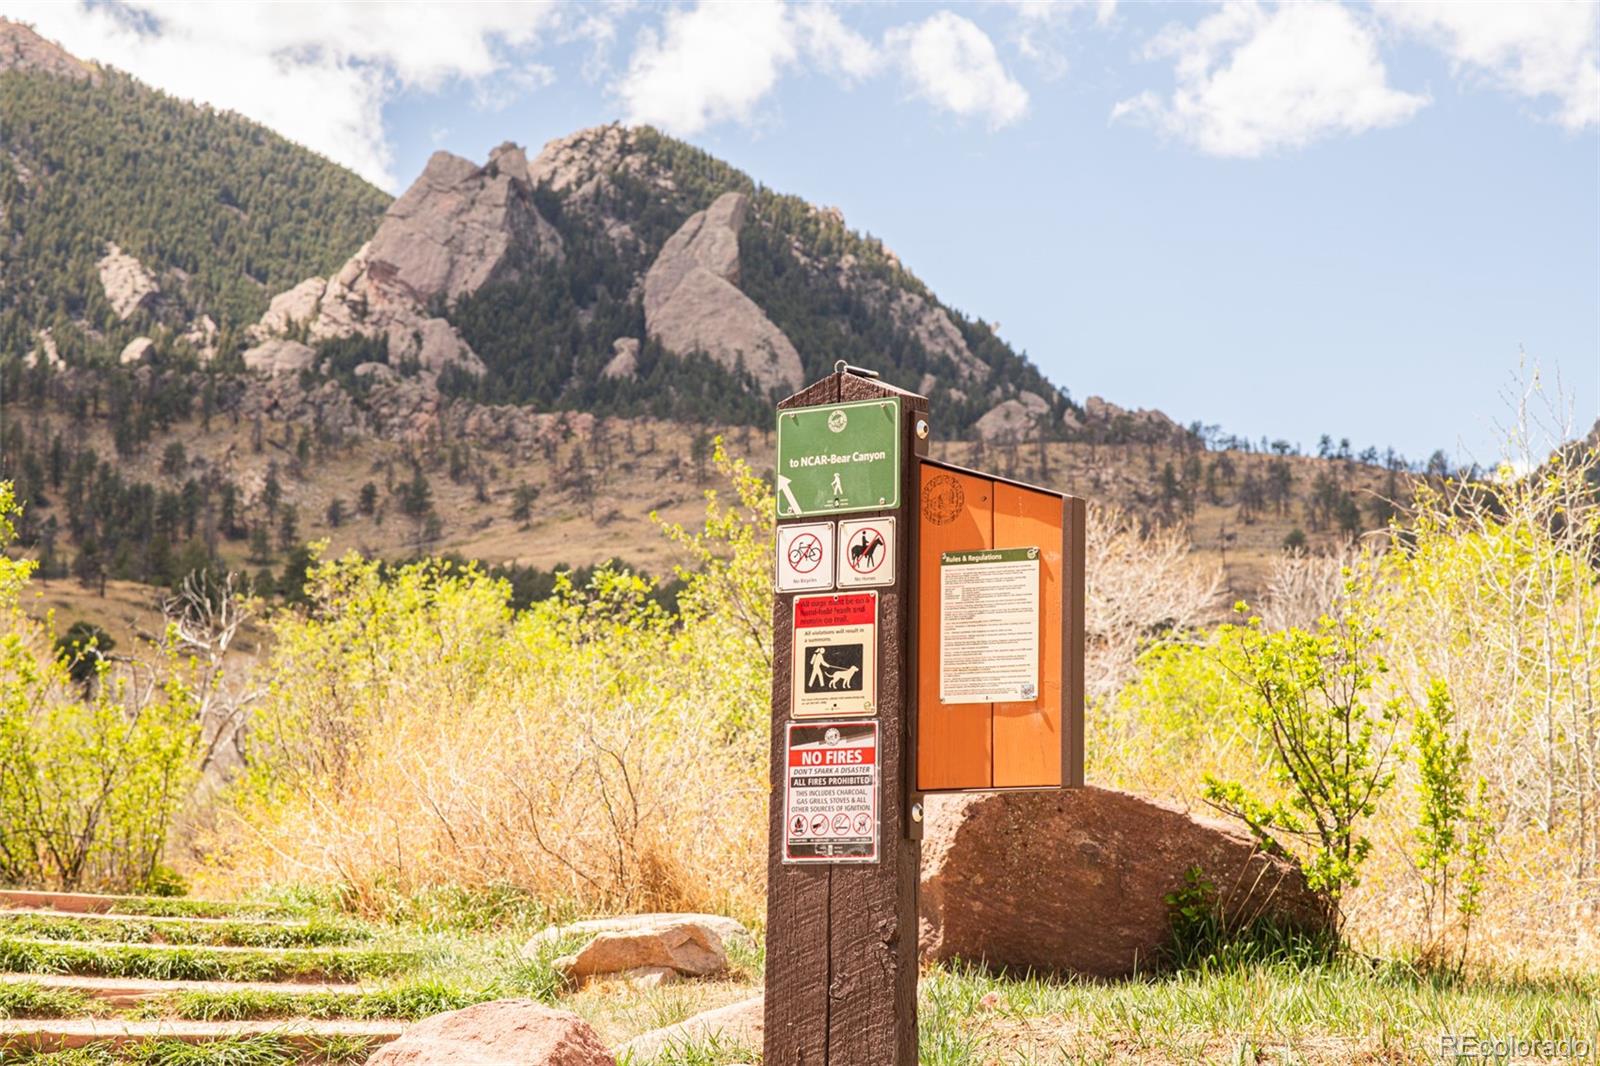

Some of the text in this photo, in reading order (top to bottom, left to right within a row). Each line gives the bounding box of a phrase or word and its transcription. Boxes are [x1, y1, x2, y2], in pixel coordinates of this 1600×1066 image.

[790, 451, 886, 468] to NCAR-Bear Canyon
[968, 554, 1002, 562] Regulations
[800, 608, 832, 616] hand-held
[802, 750, 863, 765] NO FIRES
[828, 776, 870, 785] PROHIBITED
